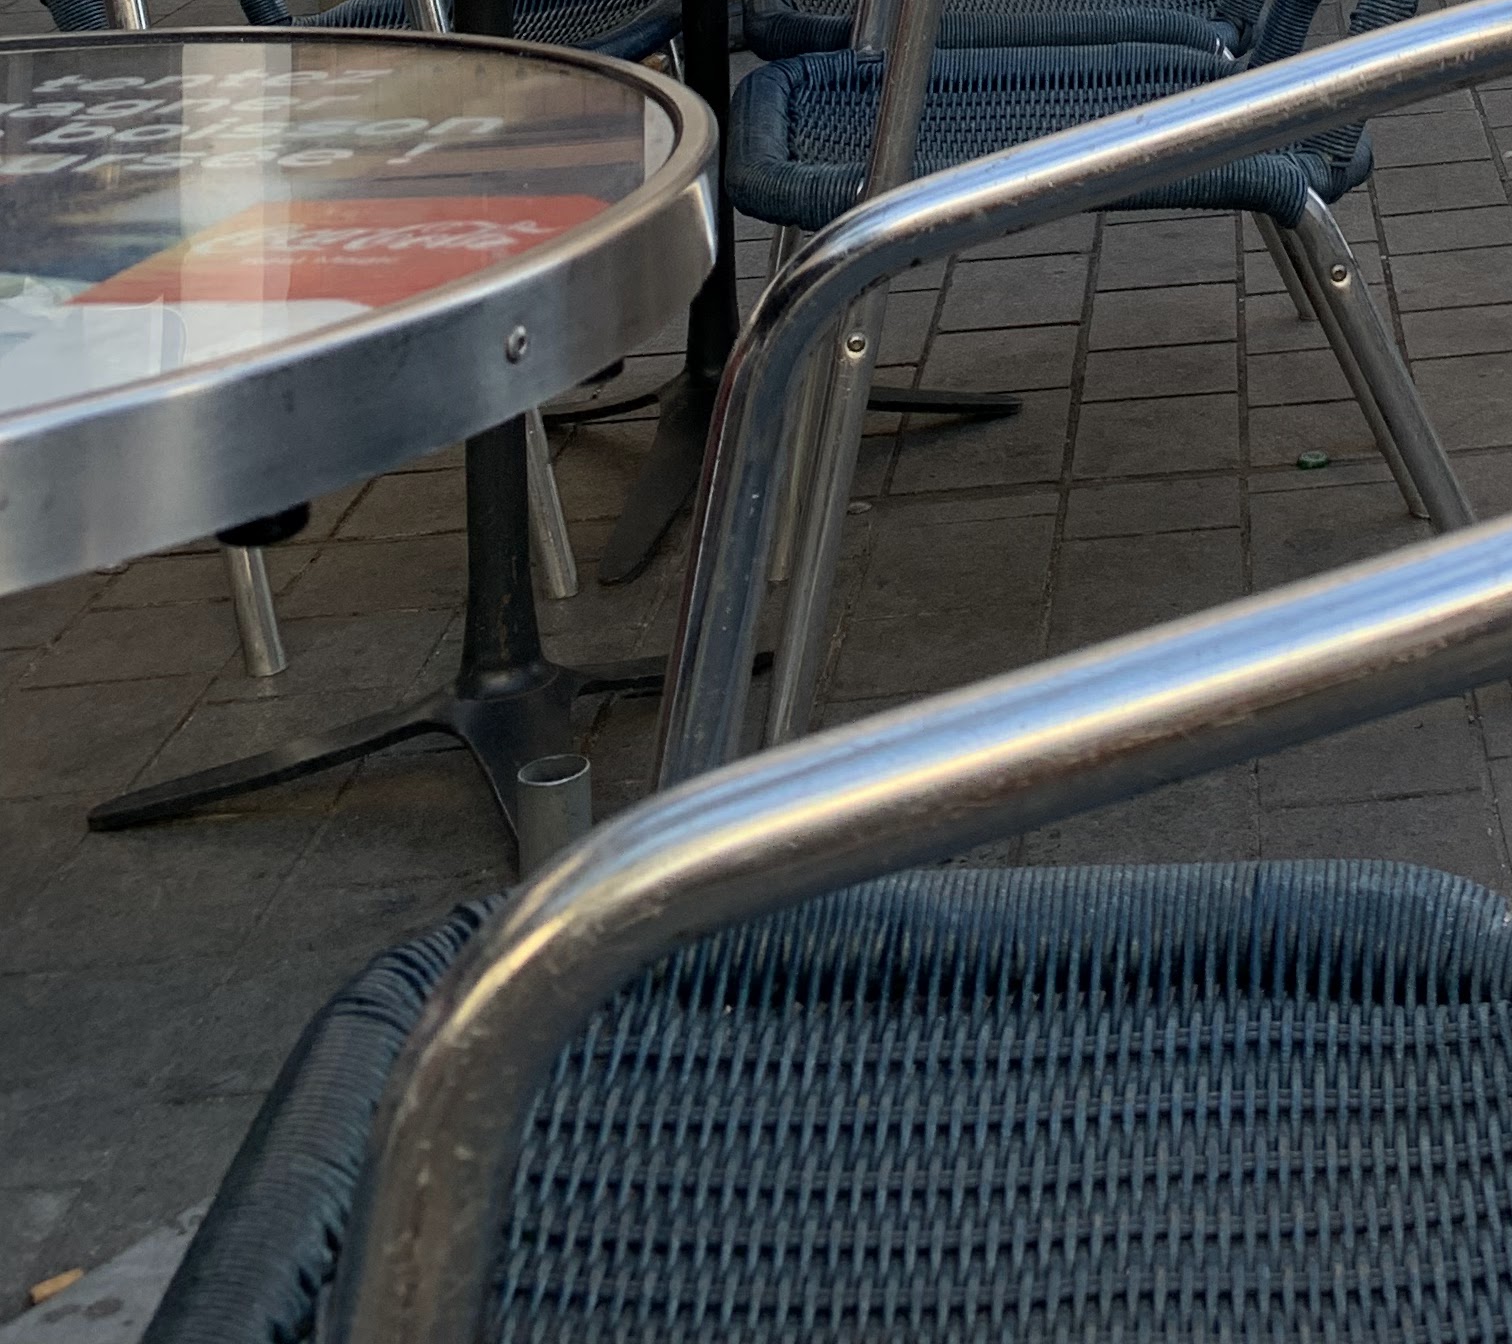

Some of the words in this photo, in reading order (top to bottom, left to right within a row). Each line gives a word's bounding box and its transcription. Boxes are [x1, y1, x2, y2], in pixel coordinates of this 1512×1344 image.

[32, 68, 396, 93] tentez
[27, 115, 505, 145] boisson
[0, 144, 354, 174] ursée
